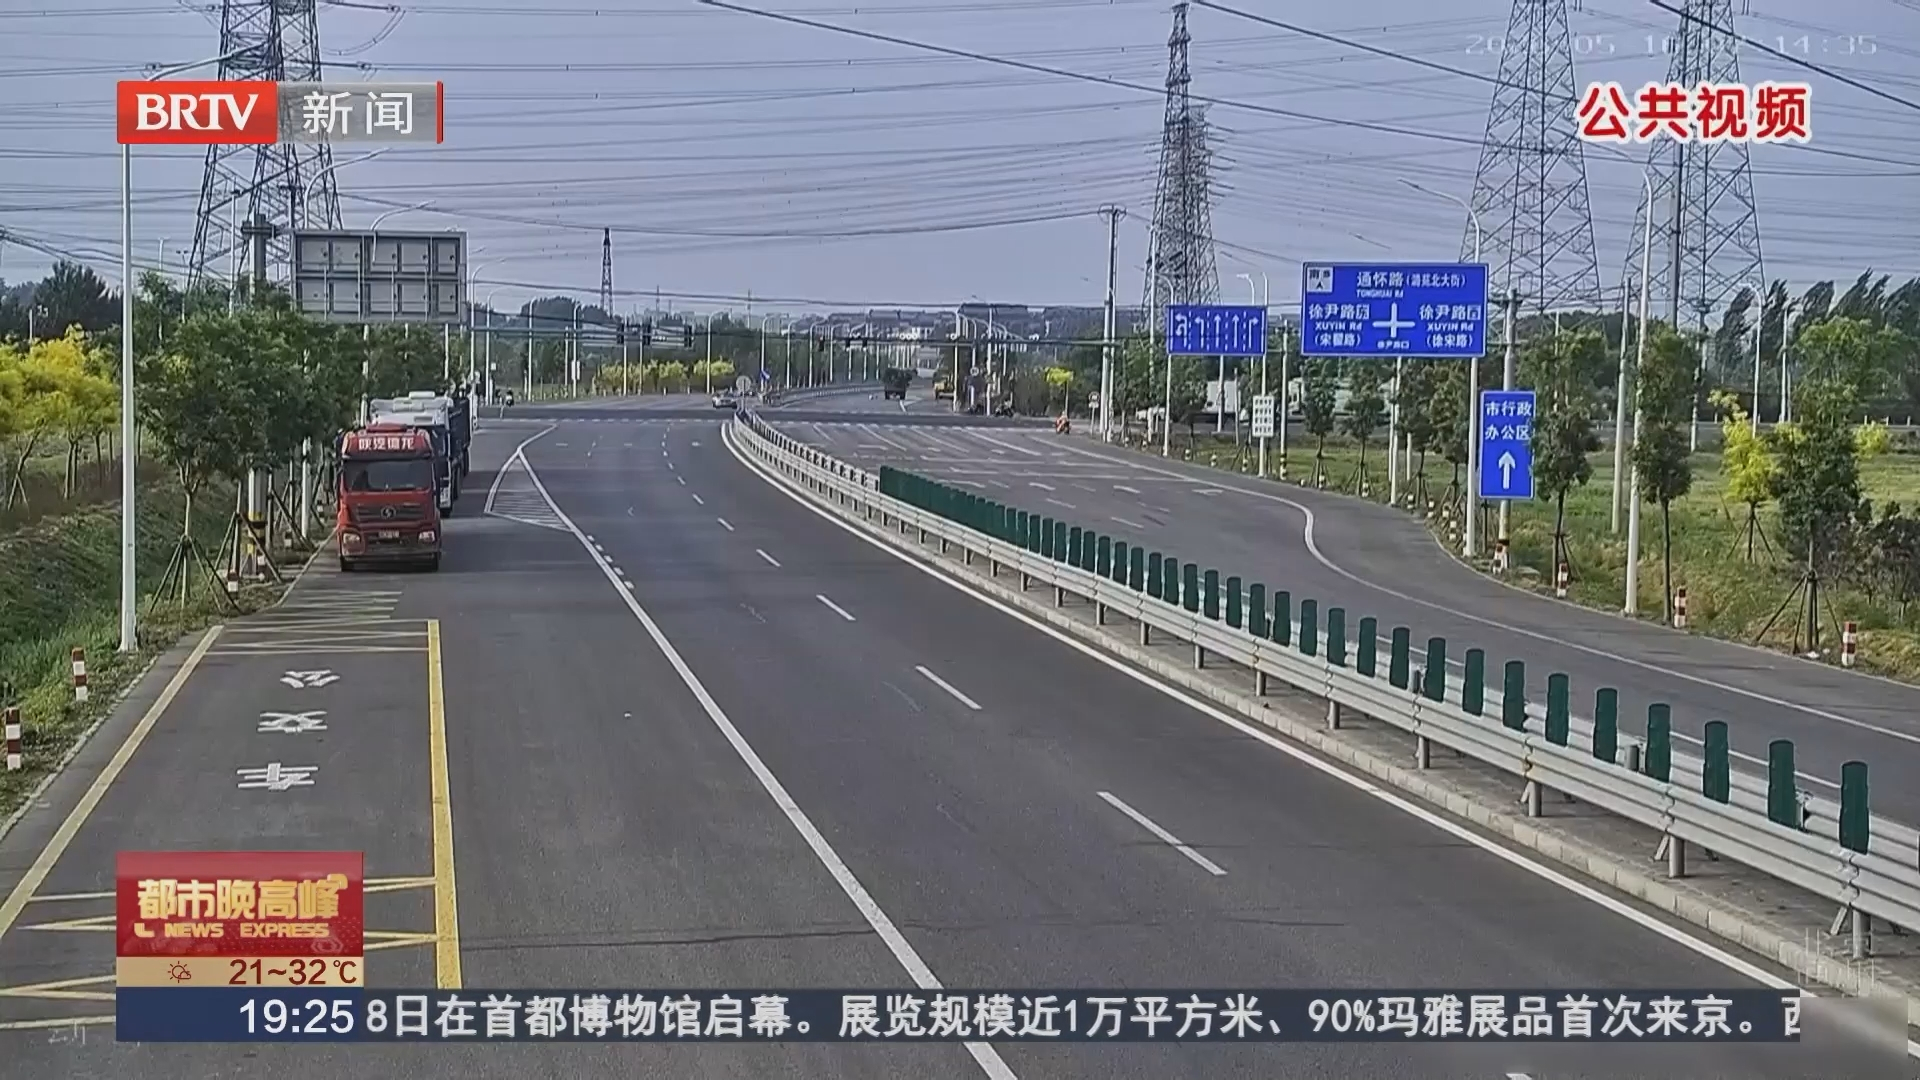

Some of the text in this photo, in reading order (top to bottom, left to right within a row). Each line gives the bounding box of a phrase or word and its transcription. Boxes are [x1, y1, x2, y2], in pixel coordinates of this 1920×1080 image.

[1315, 321, 1346, 331] XUYIN
[1427, 322, 1458, 332] XUYIN
[1484, 400, 1533, 417] 市行政
[1484, 424, 1530, 440] 办公区
